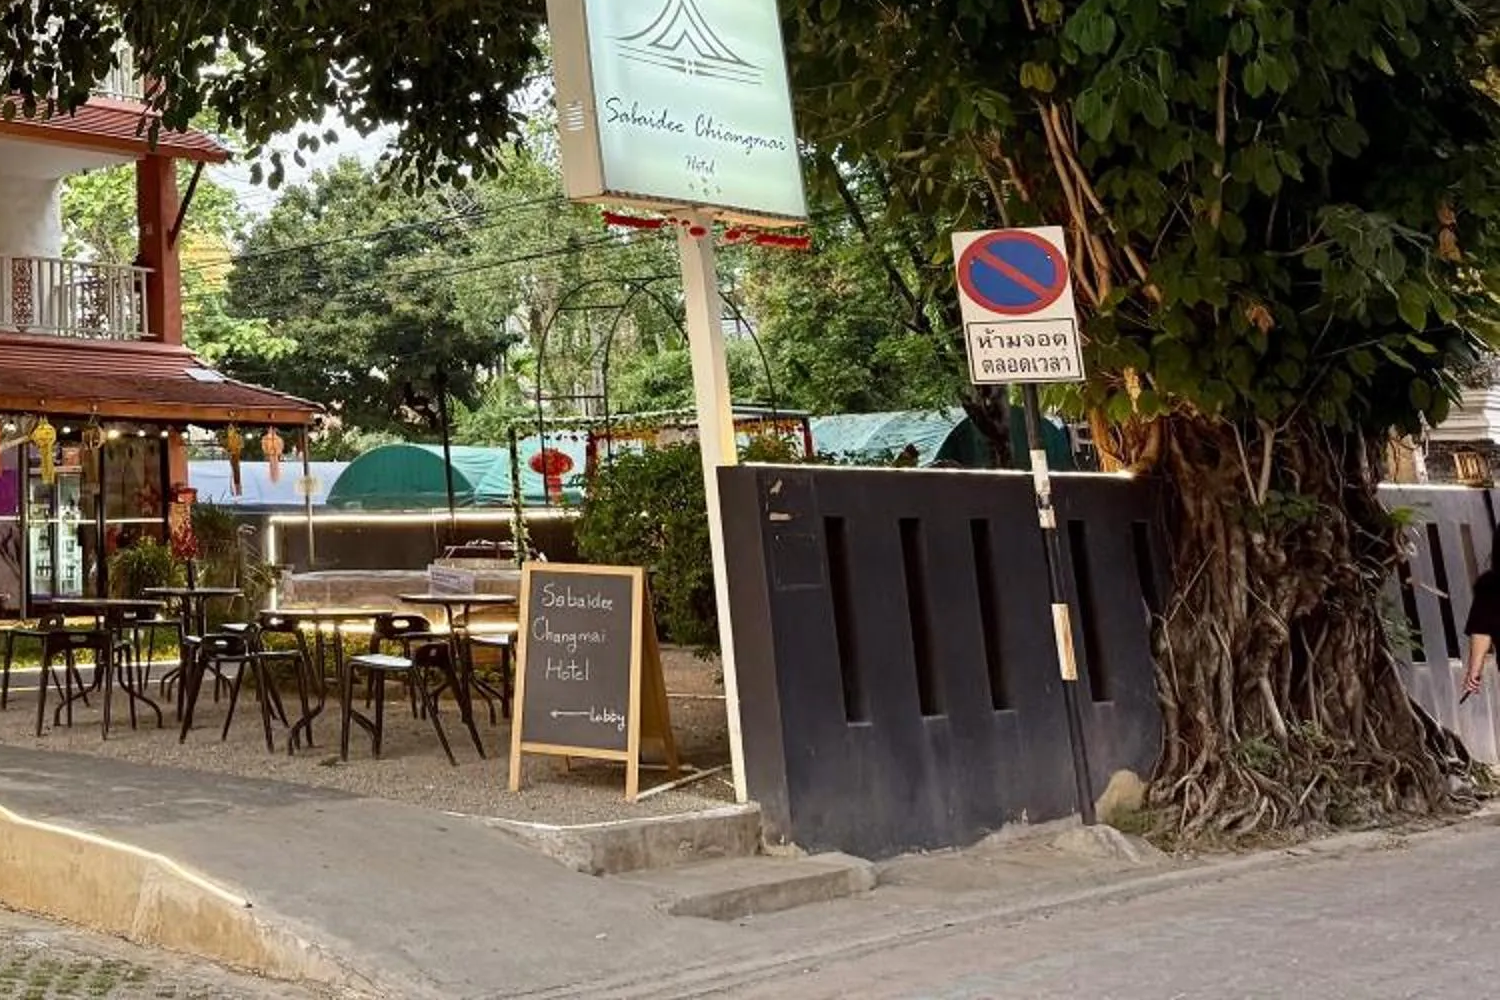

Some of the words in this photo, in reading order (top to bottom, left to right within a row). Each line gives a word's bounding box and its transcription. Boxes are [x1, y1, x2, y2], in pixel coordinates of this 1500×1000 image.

[605, 97, 685, 133] Sabaidee
[695, 113, 787, 155] Chiangmai
[685, 155, 715, 175] Hotel
[977, 328, 1067, 349] ห้ามจอด
[981, 356, 1071, 373] ตลอดเวลา
[543, 583, 613, 610] Sabaidee
[545, 656, 589, 680] Hotel
